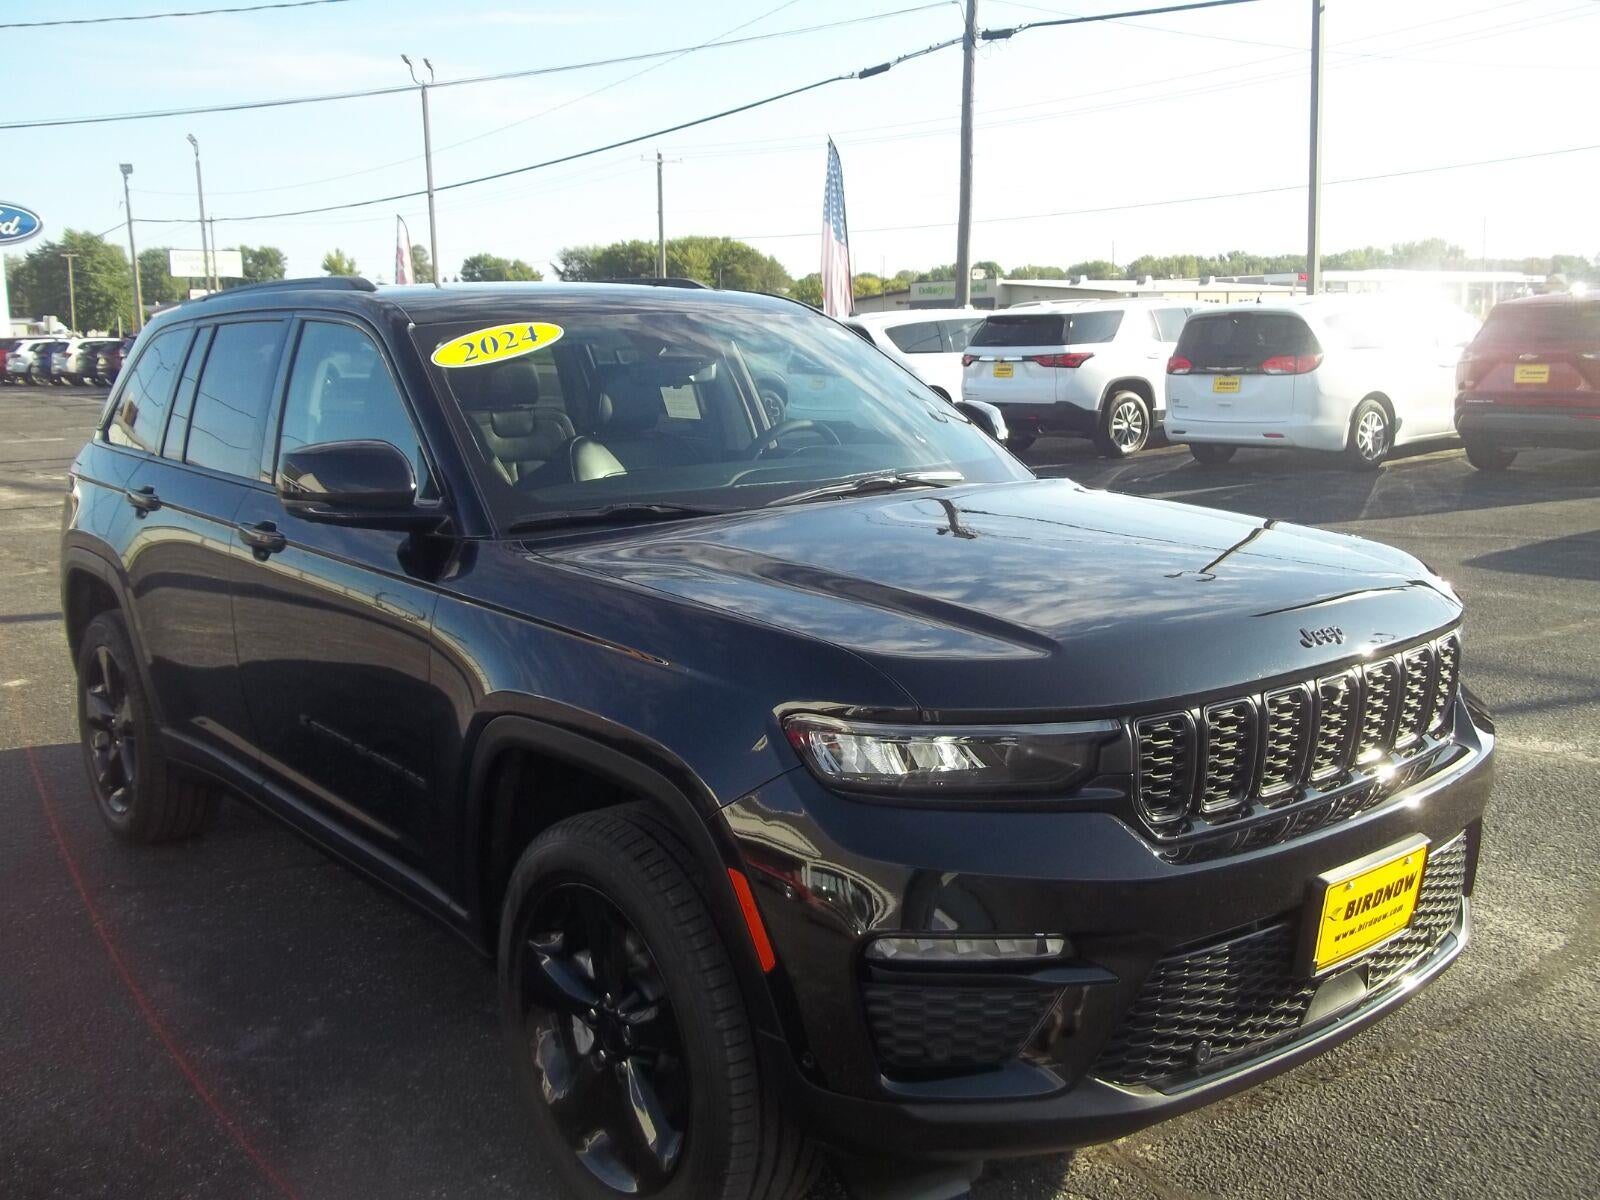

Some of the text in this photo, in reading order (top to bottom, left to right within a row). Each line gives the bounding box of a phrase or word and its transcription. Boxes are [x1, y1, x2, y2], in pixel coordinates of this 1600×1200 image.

[459, 326, 538, 361] 2024
[1299, 626, 1343, 648] Jeep
[1343, 871, 1418, 920] BIRDNOW
[1334, 904, 1403, 942] www.birdnow.com
